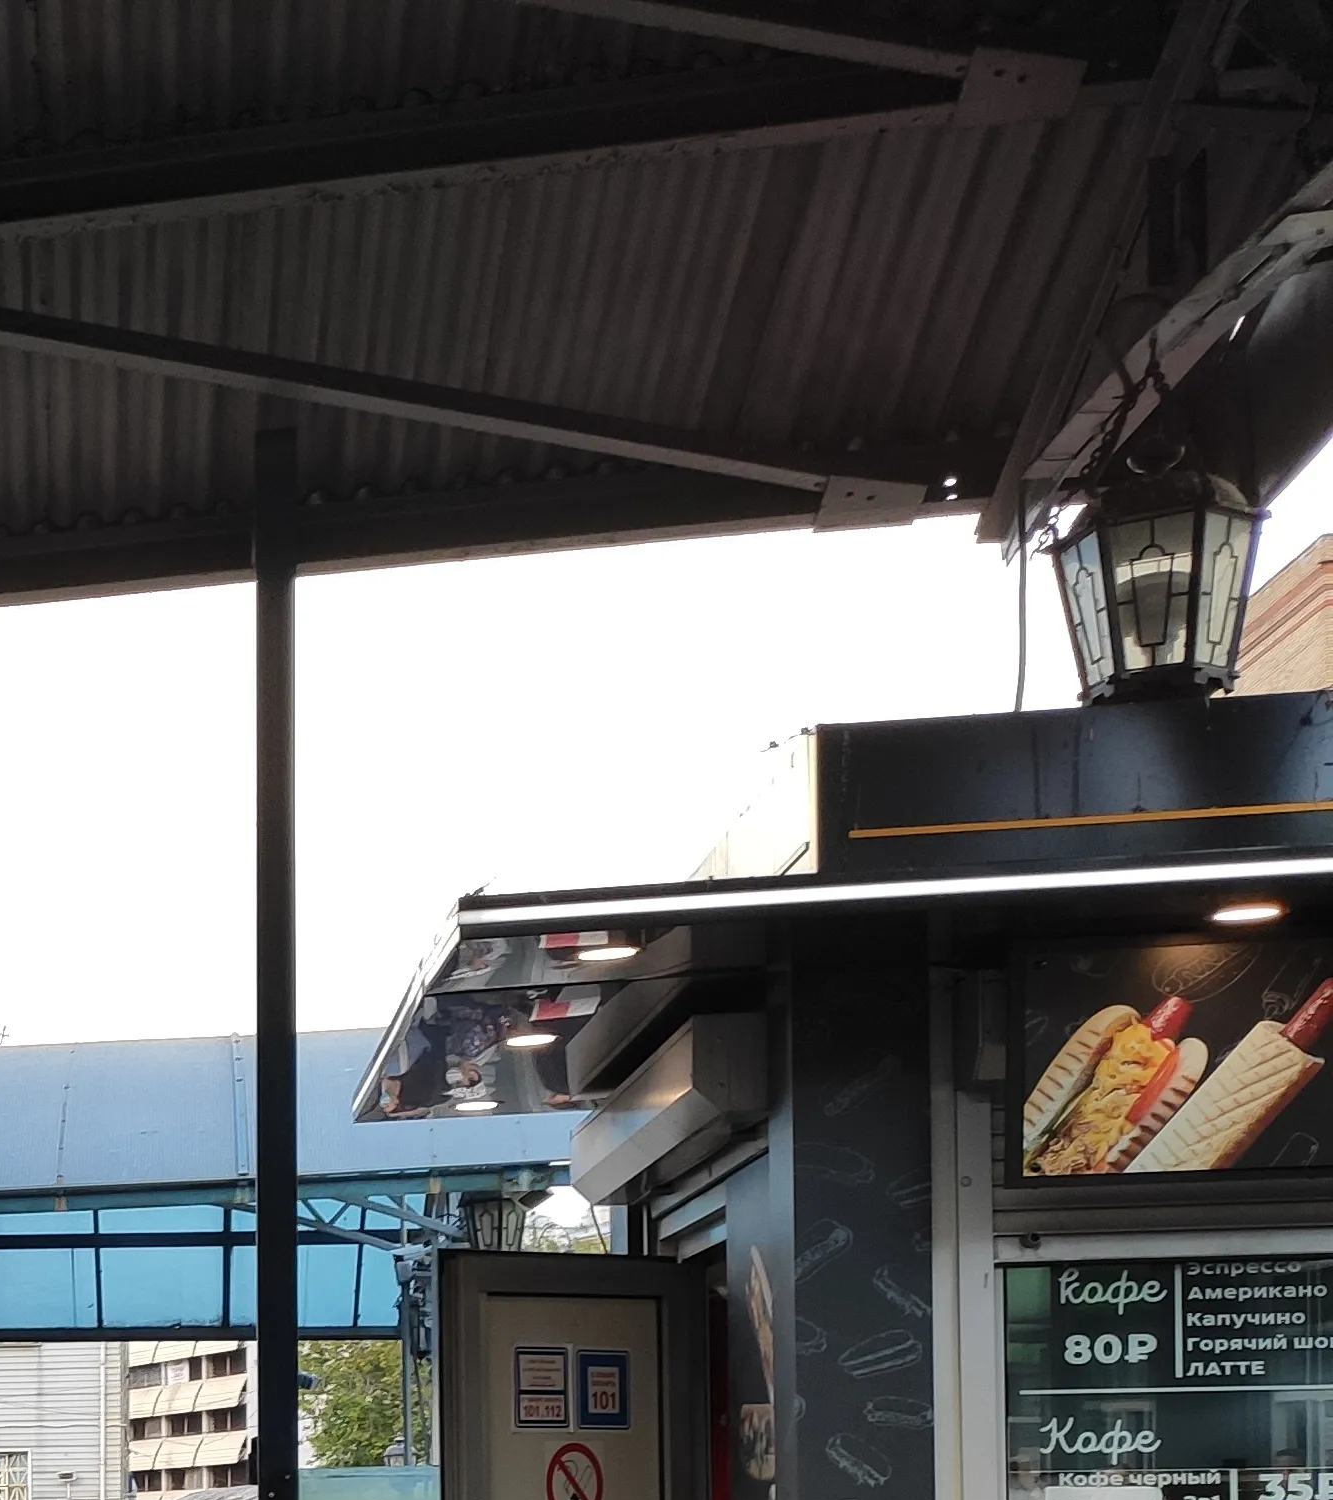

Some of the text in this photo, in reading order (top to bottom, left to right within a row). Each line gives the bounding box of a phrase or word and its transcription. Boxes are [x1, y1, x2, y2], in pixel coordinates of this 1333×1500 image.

[1186, 1261, 1302, 1277] Эспрессо
[1187, 1284, 1329, 1302] Американо
[1185, 1311, 1306, 1330] Капучино
[1186, 1333, 1333, 1354] Горячий шо
[1185, 1360, 1266, 1377] ЛАТТЕ
[591, 1391, 617, 1410] 101
[1039, 1416, 1162, 1465] Кофе
[1058, 1469, 1221, 1488] Кофе черный
